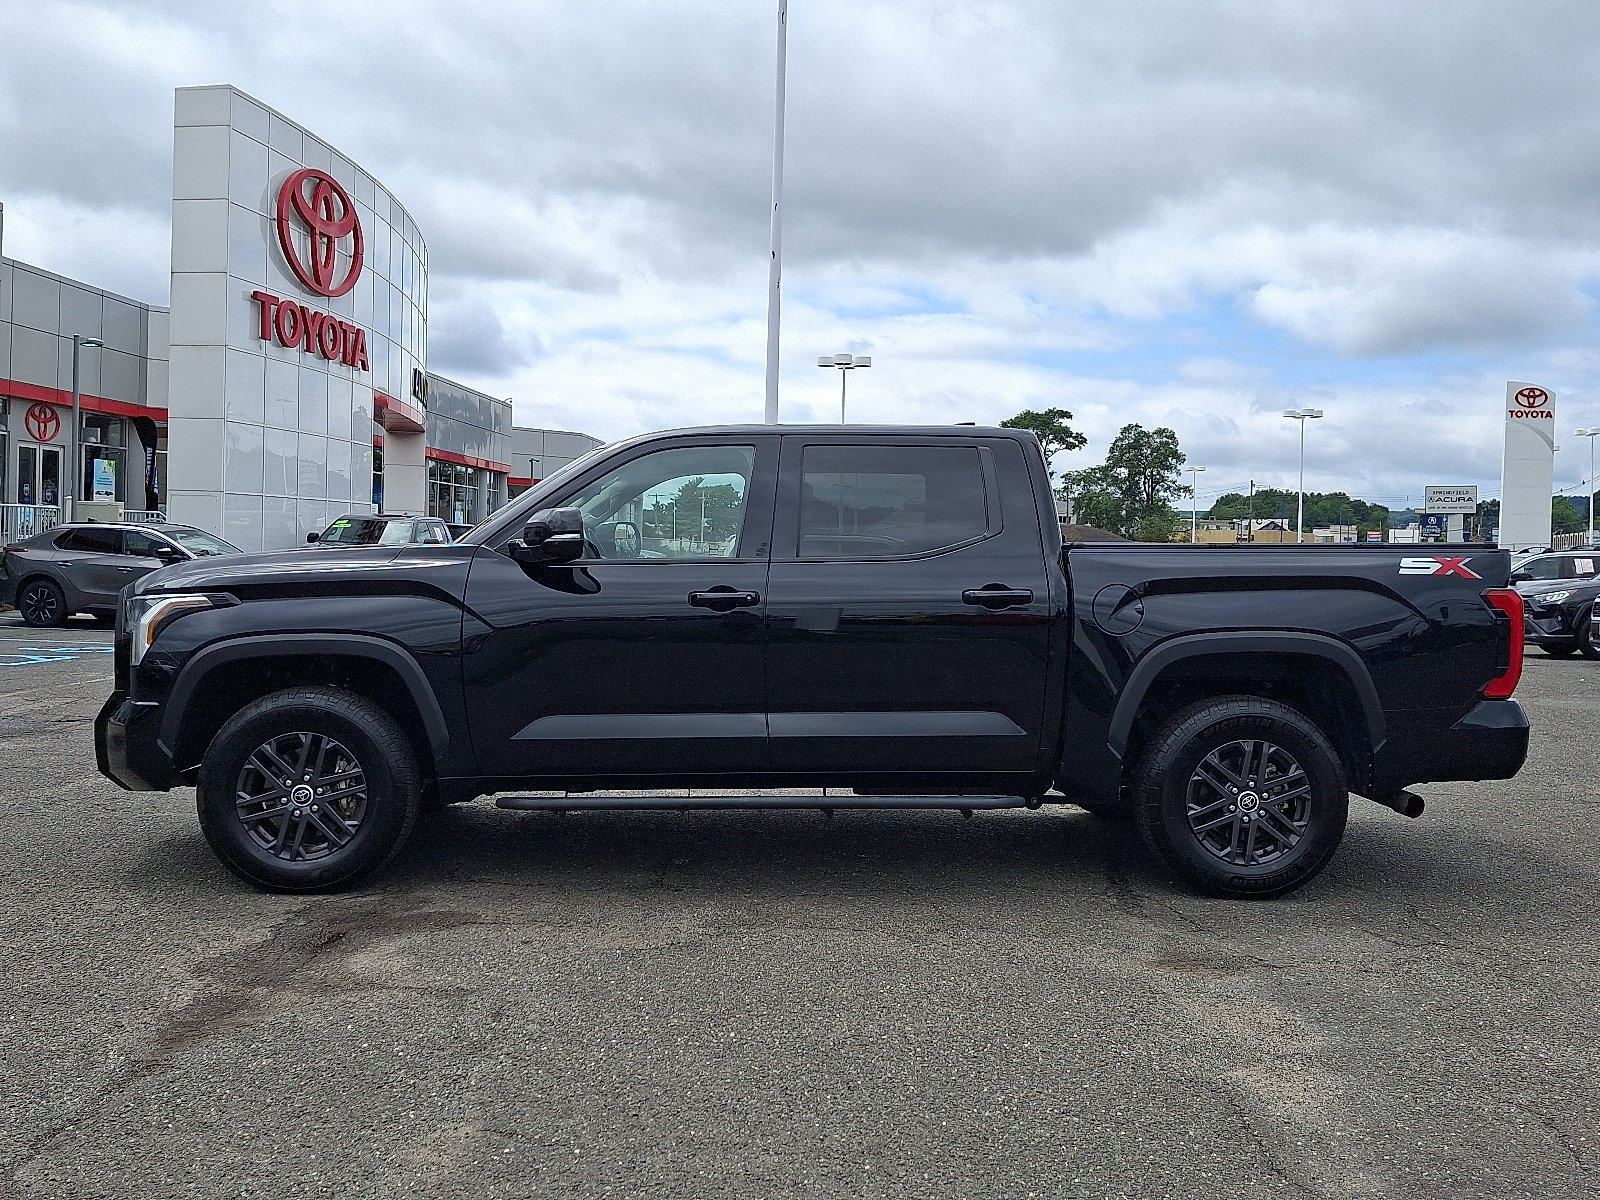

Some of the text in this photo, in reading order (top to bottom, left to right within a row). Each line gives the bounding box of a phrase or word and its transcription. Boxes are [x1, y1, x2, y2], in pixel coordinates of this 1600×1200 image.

[251, 290, 369, 372] TOYOTA
[1508, 410, 1553, 419] TOYOTA
[1398, 557, 1484, 580] SX
